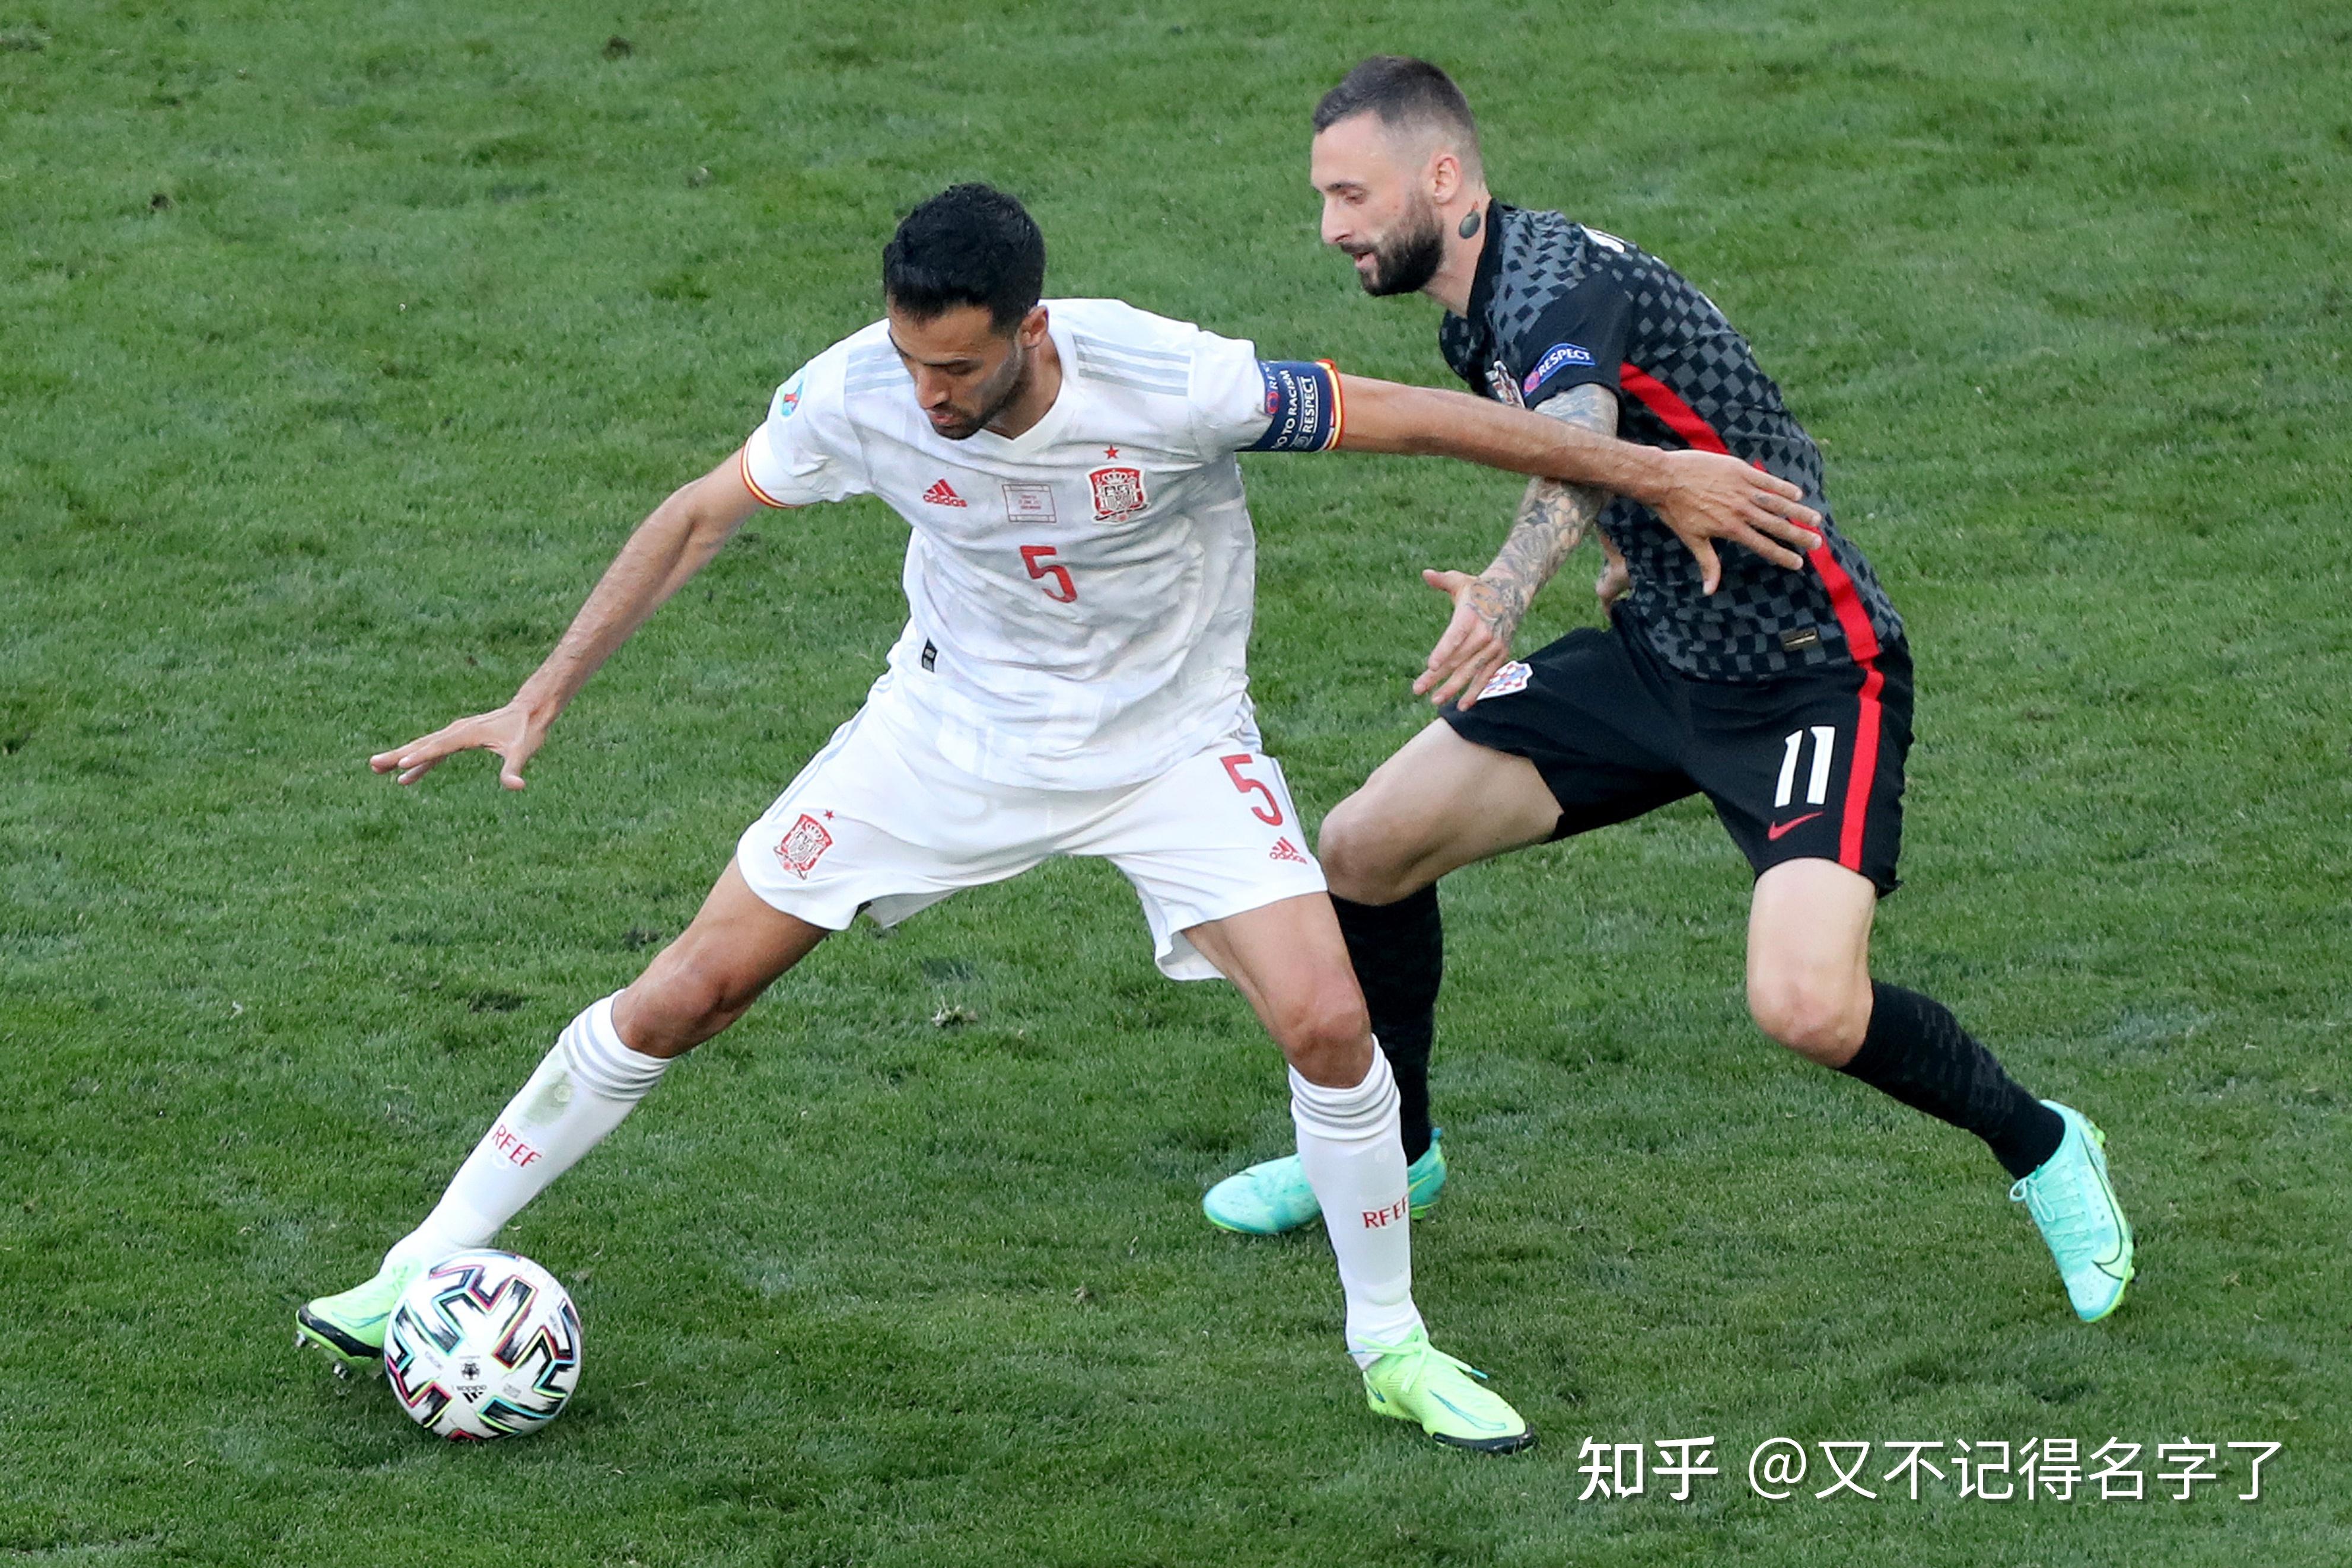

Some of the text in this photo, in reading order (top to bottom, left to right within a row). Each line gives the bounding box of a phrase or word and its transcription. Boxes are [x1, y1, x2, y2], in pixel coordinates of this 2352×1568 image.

[1538, 348, 1590, 377] RESPECT
[1280, 369, 1297, 415] RACISM
[1300, 376, 1315, 433] RESPECT
[1281, 418, 1296, 435] TO
[1020, 545, 1077, 603] 5
[1220, 753, 1283, 826] 5
[1774, 725, 1836, 808] 11
